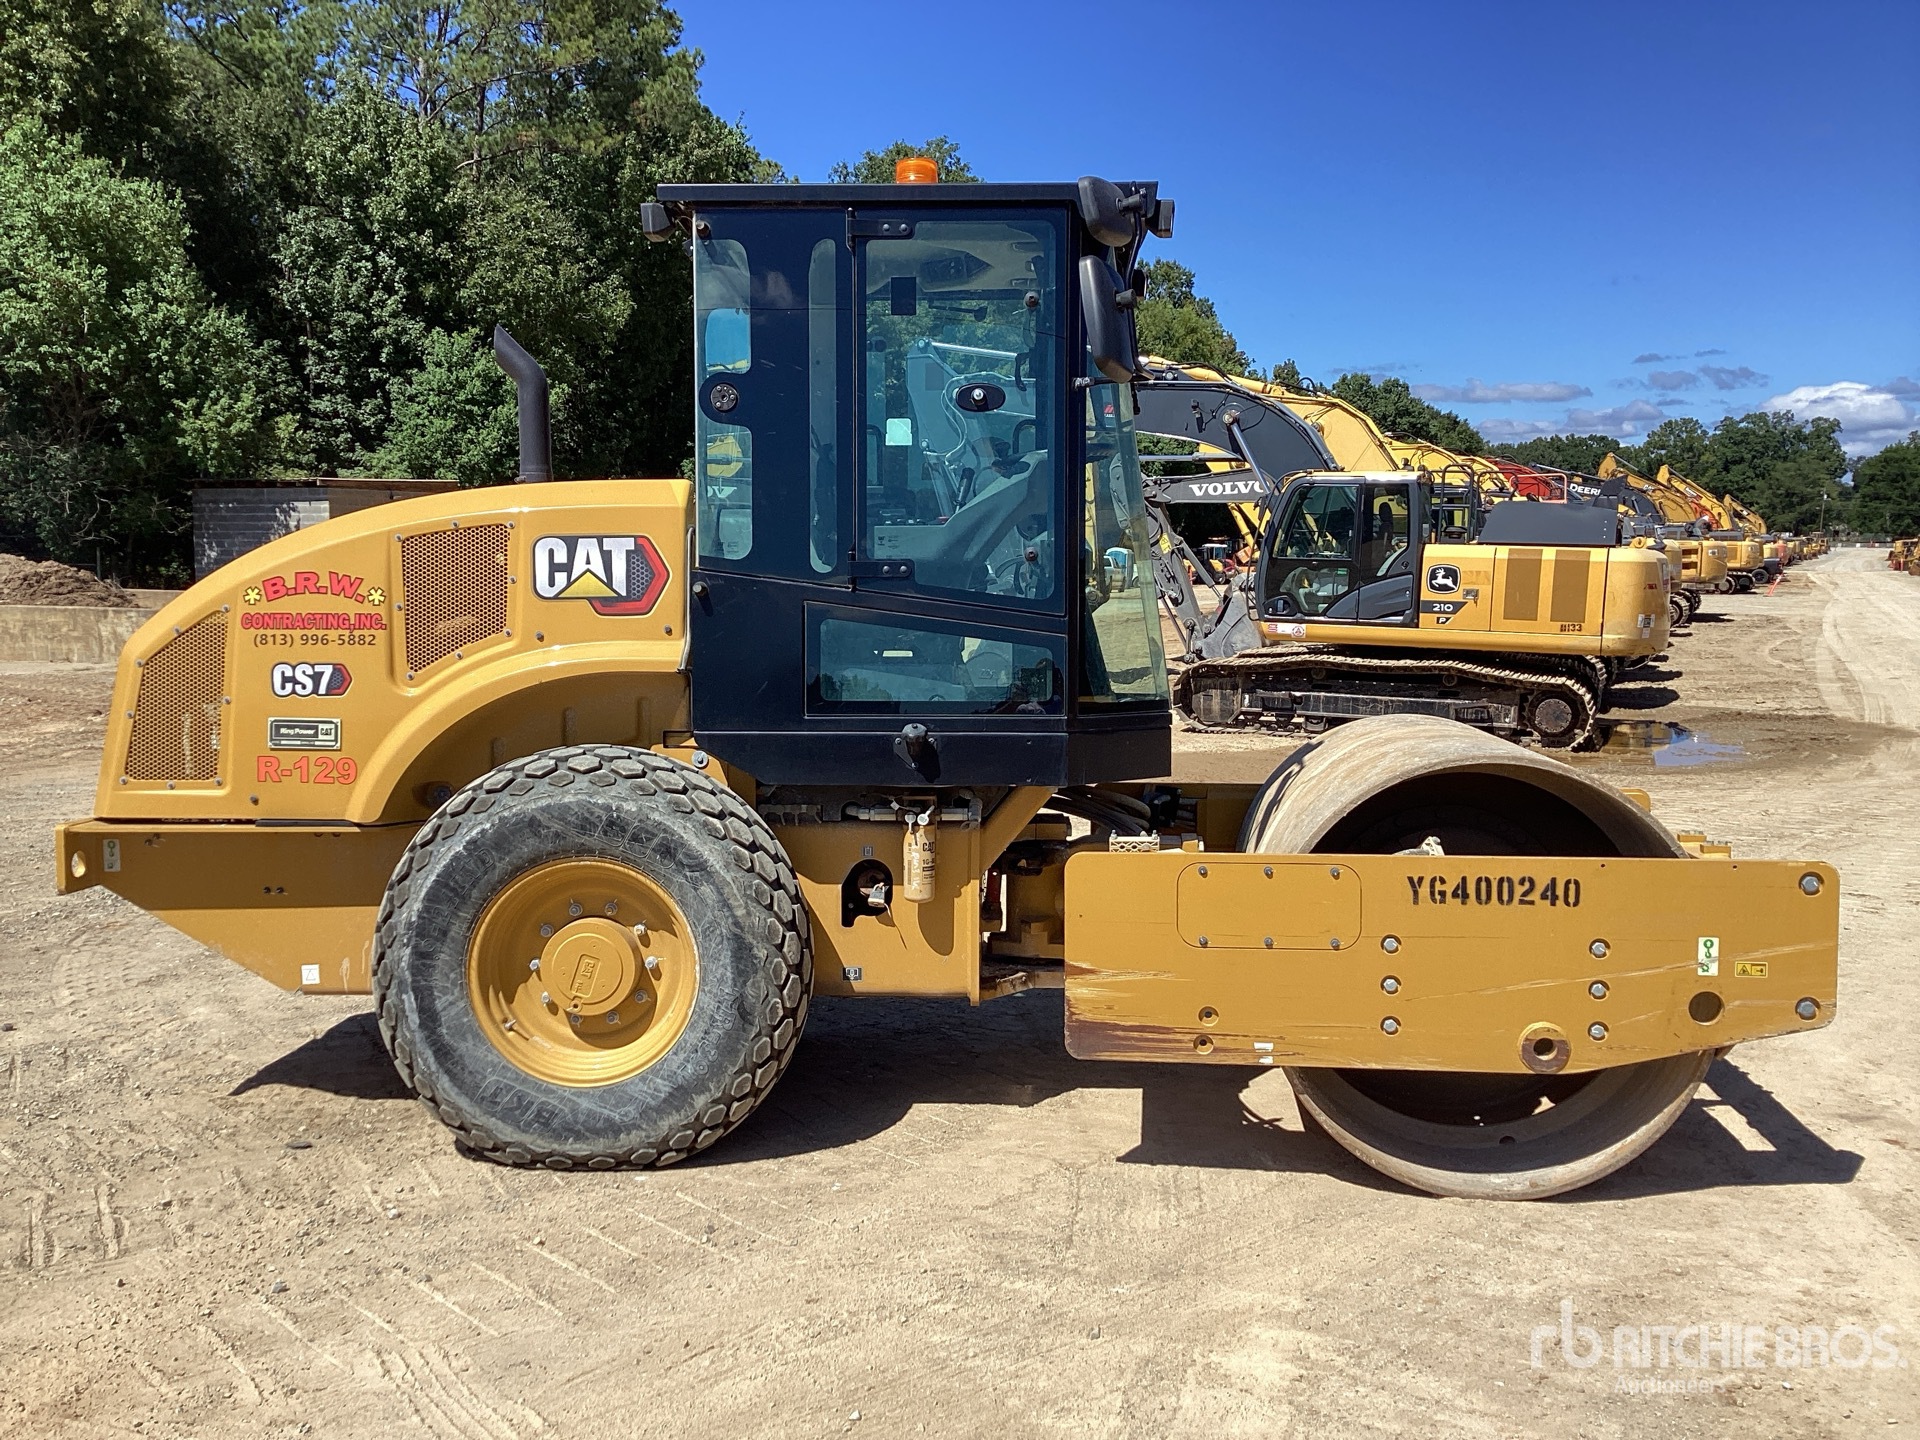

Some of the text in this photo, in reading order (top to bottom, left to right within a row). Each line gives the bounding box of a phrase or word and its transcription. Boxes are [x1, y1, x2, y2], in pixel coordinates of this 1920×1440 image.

[534, 537, 635, 598] CAT
[262, 571, 366, 604] B.R.W.
[1432, 603, 1454, 612] 210
[253, 633, 377, 648] (813) 996-5882
[272, 663, 334, 696] CS7
[320, 727, 334, 736] CAT
[256, 755, 358, 785] R-129
[1406, 875, 1581, 907] YG400240
